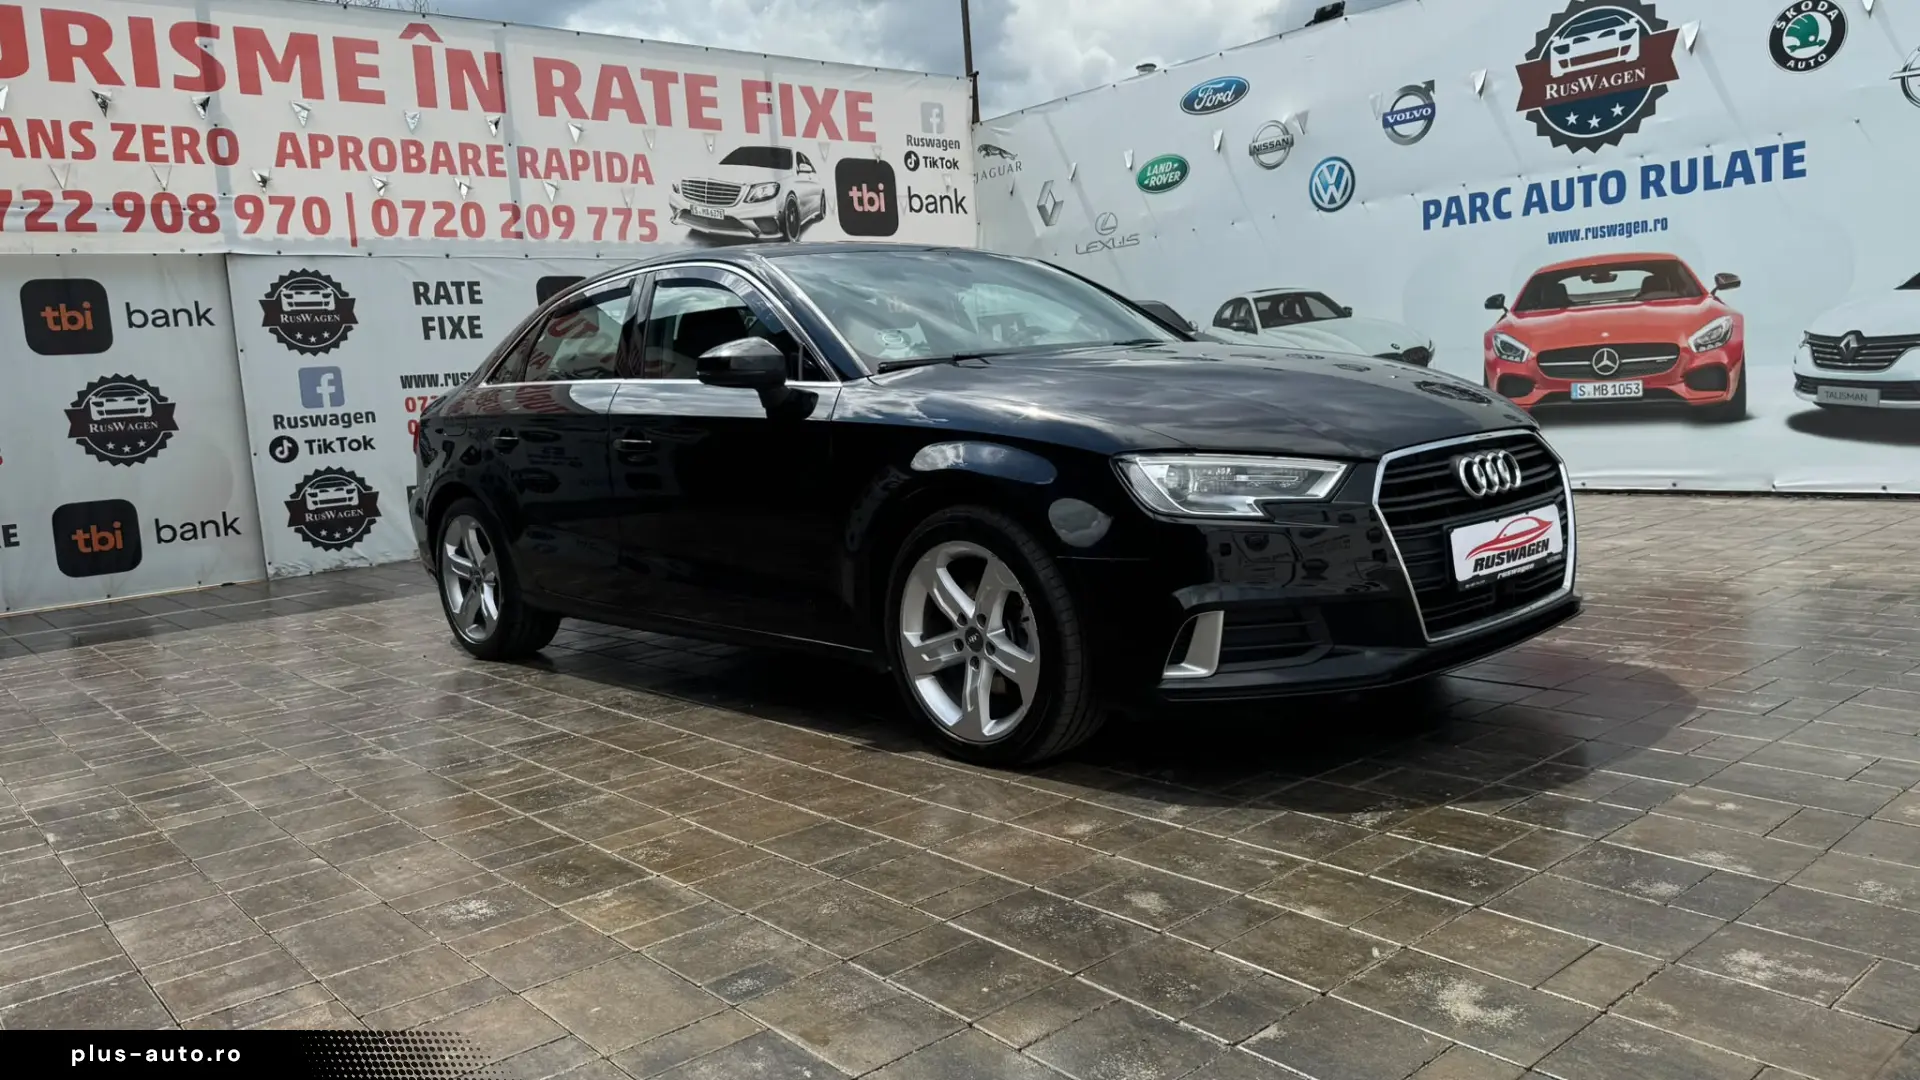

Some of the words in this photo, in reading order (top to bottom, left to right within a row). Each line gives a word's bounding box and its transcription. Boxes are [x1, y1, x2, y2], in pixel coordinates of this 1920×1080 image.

[1786, 53, 1827, 69] AUTO
[398, 23, 507, 114] ÎN
[533, 57, 723, 131] RATE
[741, 79, 877, 143] FIXE
[1192, 81, 1235, 110] Ford
[1387, 107, 1432, 123] VOLVO
[110, 122, 240, 167] ZERO
[275, 131, 507, 178] APROBARE
[517, 145, 655, 187] RAPIDA
[906, 135, 960, 151] Ruswagen
[1252, 137, 1290, 152] NISSAN
[922, 156, 960, 170] TikTok
[974, 161, 1022, 184] JAGUAR
[1147, 161, 1172, 176] LAND
[1149, 171, 1181, 187] ROVER
[1422, 187, 1512, 231] PARC
[1522, 169, 1627, 217] AUTO
[1640, 140, 1807, 200] RULATE
[848, 184, 886, 213] tbi
[907, 185, 968, 215] bank
[112, 191, 221, 234] 908
[234, 194, 331, 236] 970
[371, 198, 486, 239] 0720
[499, 203, 576, 241] 209
[581, 206, 659, 243] 775
[1547, 217, 1669, 245] www.ruswagen.ro
[412, 280, 484, 306] RATE
[40, 301, 94, 331] tbi
[125, 301, 216, 329] bank
[421, 315, 484, 341] FIXE
[1824, 390, 1868, 402] TALISMAN
[273, 411, 377, 430] Ruswagen
[304, 435, 377, 456] TikTok
[72, 521, 124, 554] tbi
[154, 511, 242, 545] bank
[1473, 538, 1550, 573] RUSWAGEN
